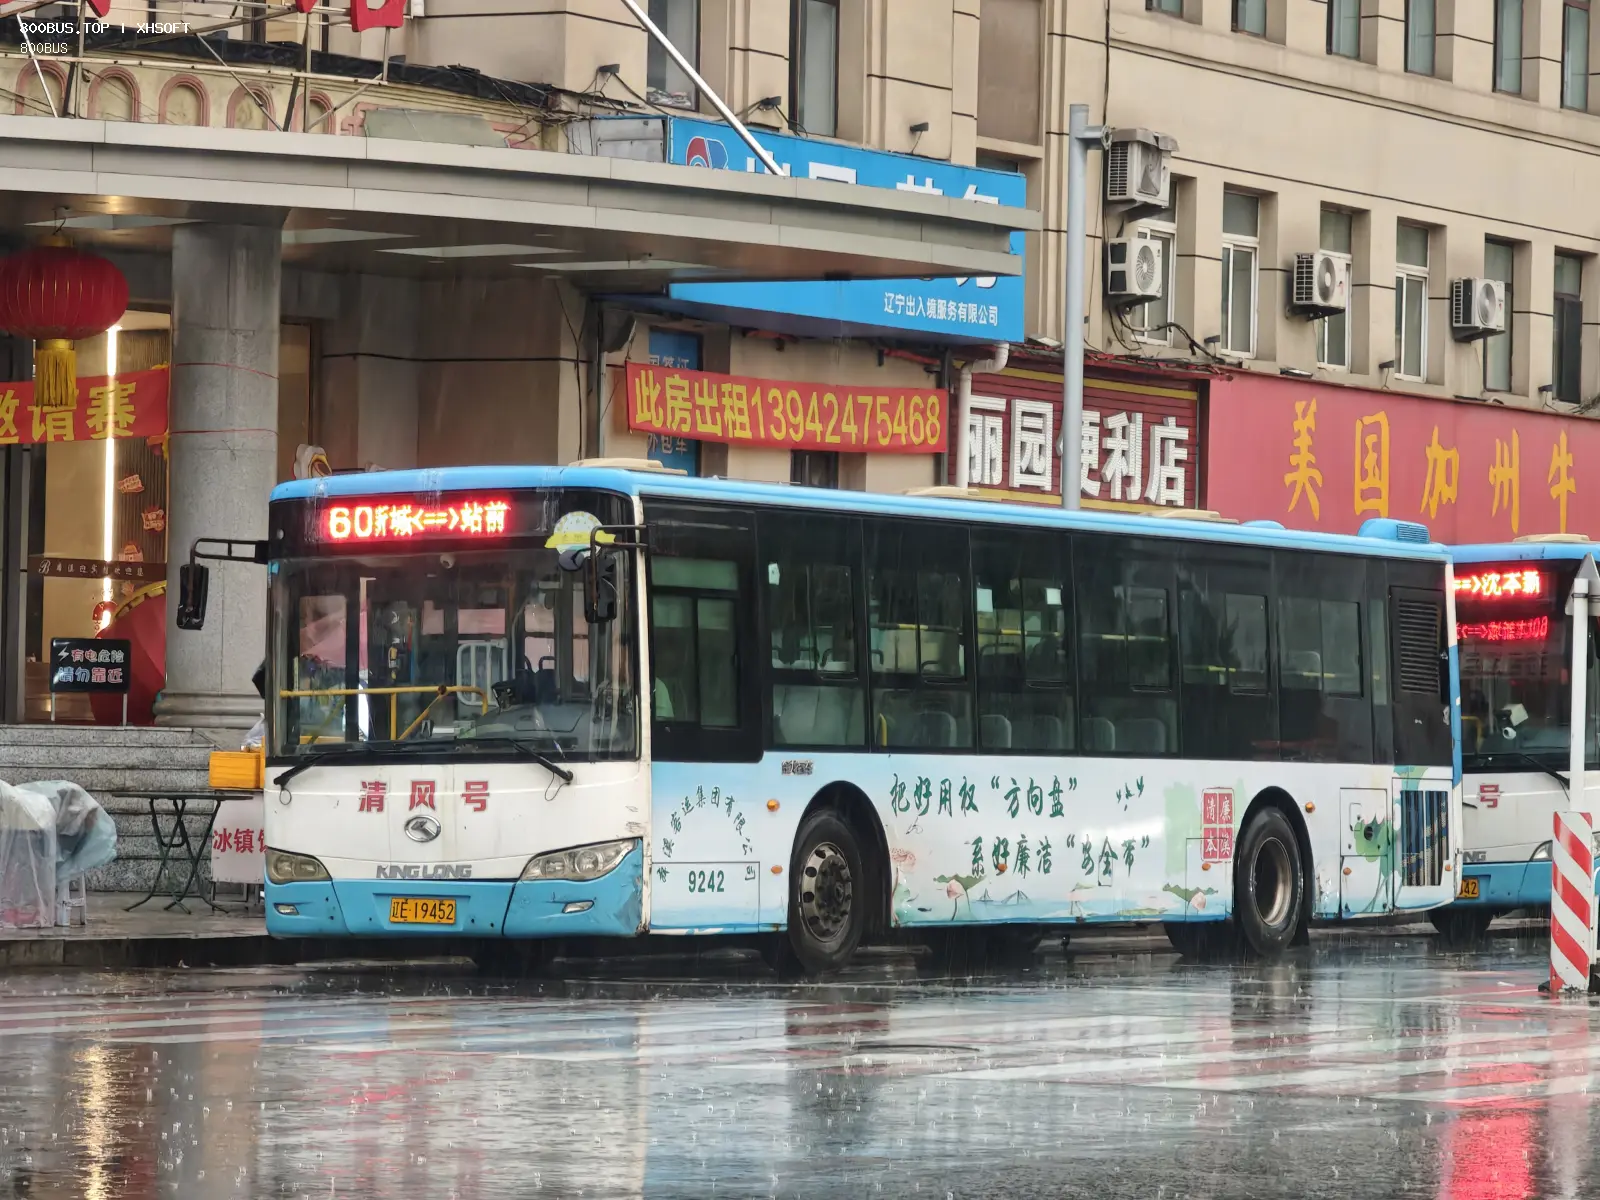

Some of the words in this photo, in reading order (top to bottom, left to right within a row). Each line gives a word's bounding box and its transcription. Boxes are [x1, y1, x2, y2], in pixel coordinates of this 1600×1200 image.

[884, 291, 999, 327] 辽宁出入境服务有限公司
[635, 369, 942, 447] 此房出租13942475468
[968, 394, 1189, 507] 丽园便利店
[1284, 397, 1577, 535] 美国加州牛
[71, 648, 125, 663] 有电危险
[56, 666, 124, 684] 请勿靠近
[358, 780, 490, 813] 清风号
[1479, 783, 1501, 809] 号
[375, 864, 421, 879] KING
[421, 864, 473, 879] LONG
[688, 869, 726, 893] 9242
